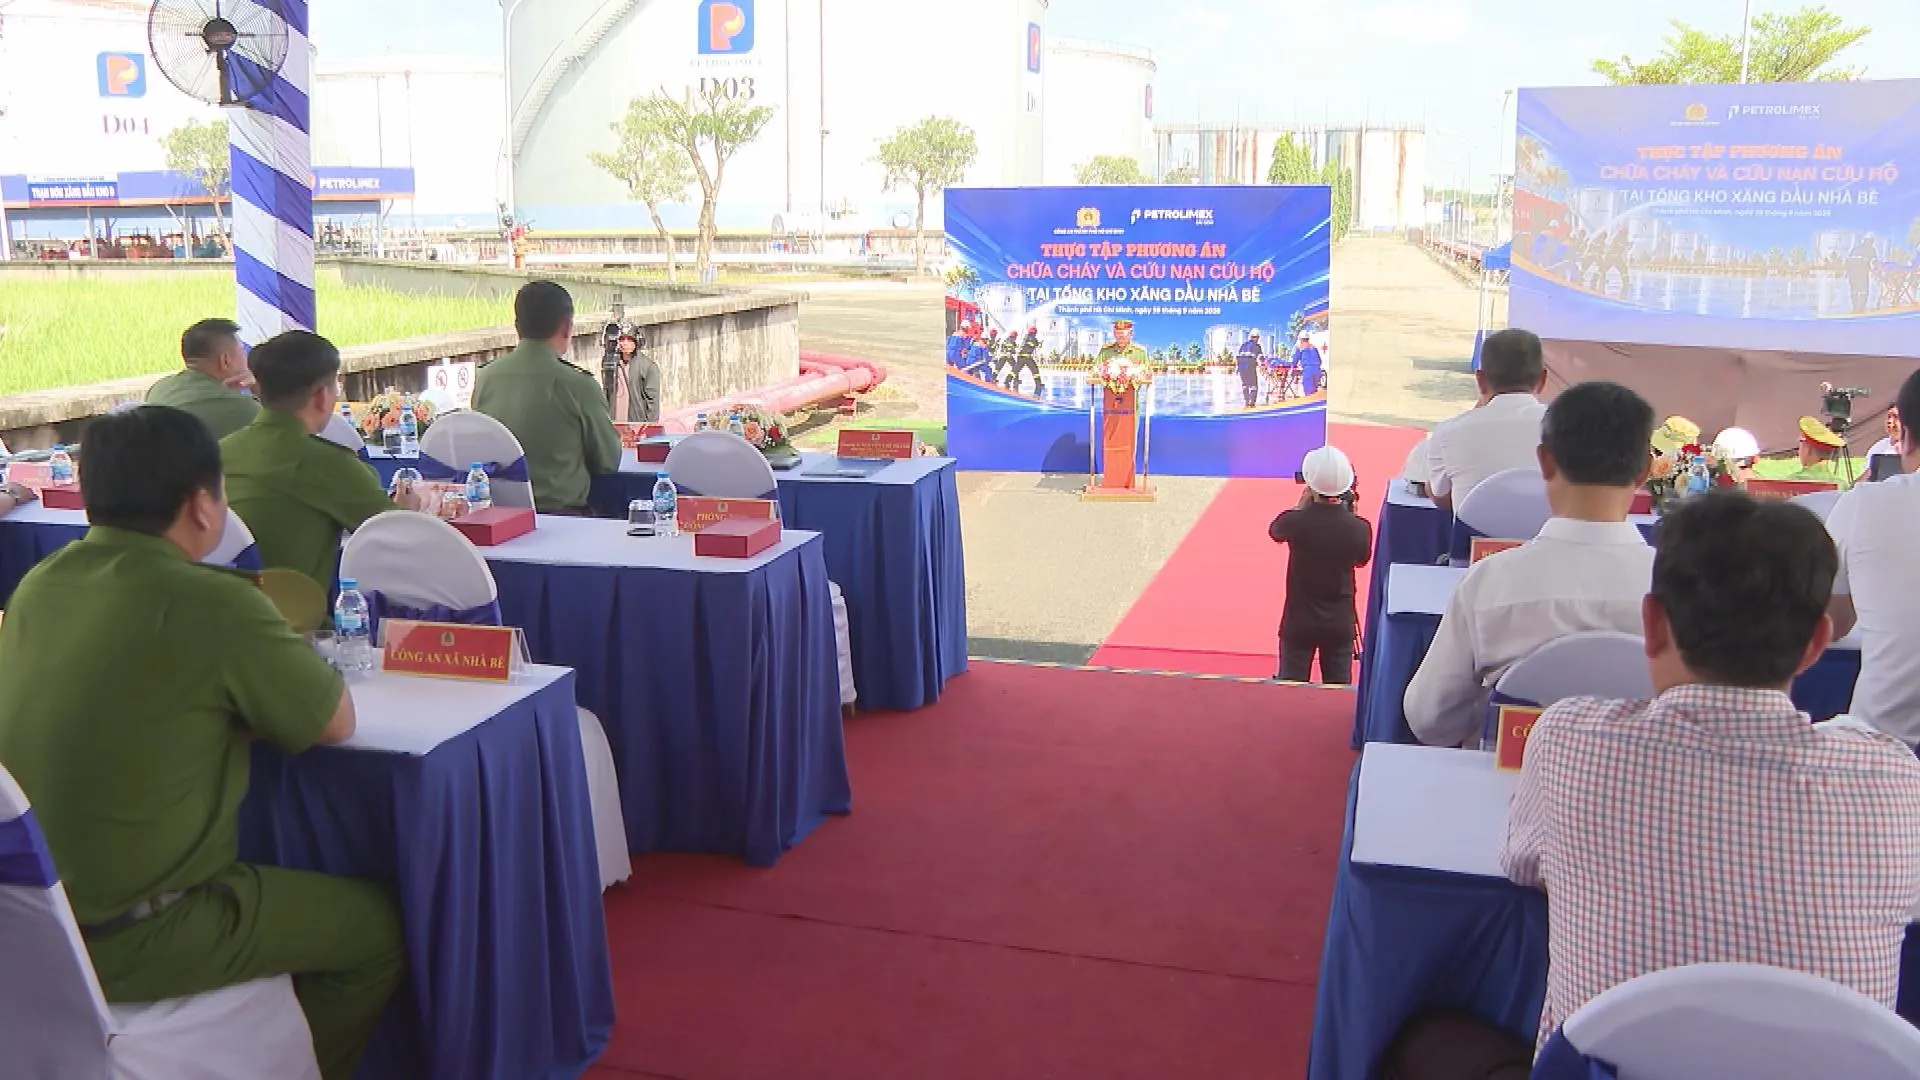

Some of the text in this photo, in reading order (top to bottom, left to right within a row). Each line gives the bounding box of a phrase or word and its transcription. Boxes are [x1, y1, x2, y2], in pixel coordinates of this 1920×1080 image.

[1742, 103, 1820, 116] PETROLIMEX
[320, 177, 380, 189] PETROLIMEX
[1600, 163, 1898, 185] CHỮA CHÁY VÀ CỨU NẠN CỨU HỘ
[1620, 189, 1643, 205] TẠI
[1648, 186, 1691, 203] TỔNG
[1694, 189, 1727, 203] KHO
[1731, 187, 1776, 204] XĂNG
[1781, 182, 1813, 205] DẦU
[1817, 188, 1852, 205] NHÀ
[1144, 209, 1214, 219] PETROLIMEX
[1041, 240, 1226, 260] THỰC TẬP PHƯƠNG ÁN
[1007, 261, 1275, 282] CHỮA CHÁY VÀ CỨU NẠN CỨU HỘ
[1028, 280, 1261, 304] TẠI TỔNG KHO XĂNG DẦU NHÀ BÈ
[696, 511, 728, 521] PHÒNG
[391, 648, 423, 663] CÔNG
[425, 653, 442, 663] AN
[443, 652, 460, 666] XÃ
[463, 653, 488, 667] NHÀ
